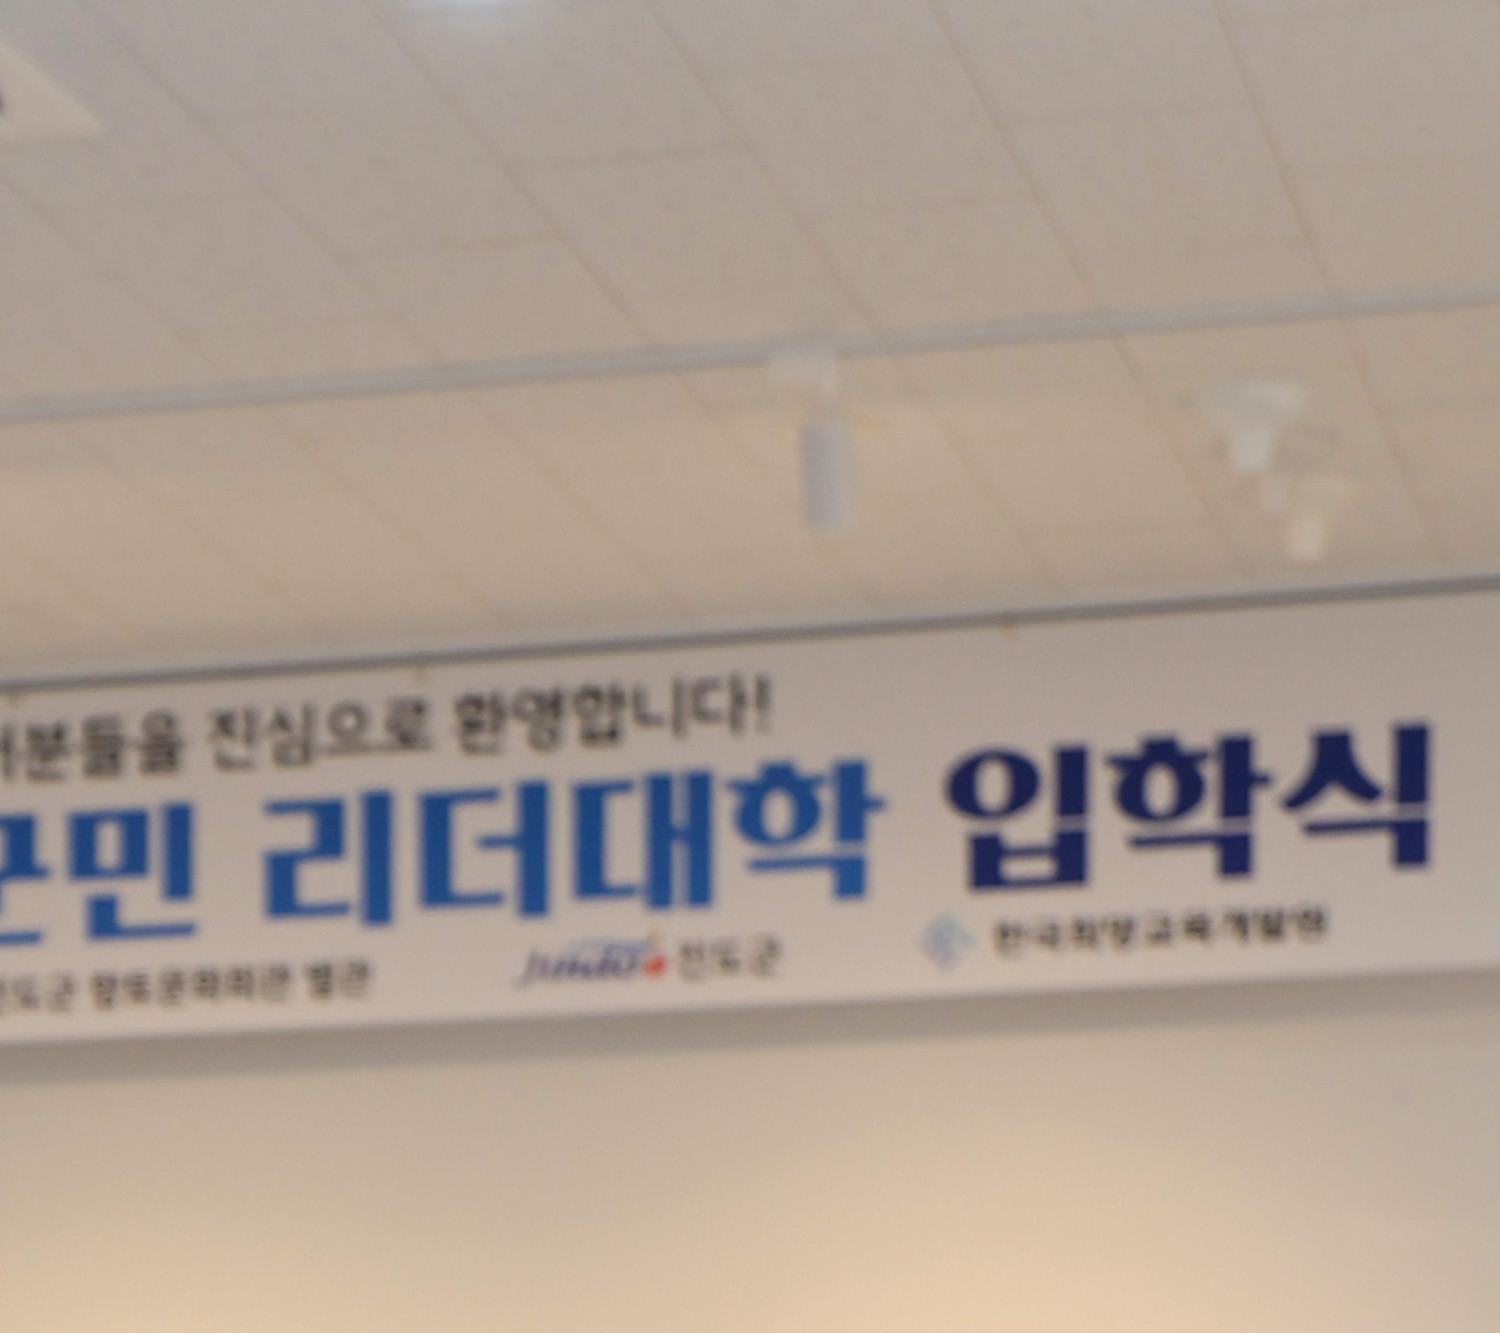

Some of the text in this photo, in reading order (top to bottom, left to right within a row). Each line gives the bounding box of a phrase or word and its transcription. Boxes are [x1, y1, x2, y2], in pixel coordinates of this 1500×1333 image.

[209, 698, 432, 771] 진심으로
[455, 675, 772, 755] 환영합니다!
[262, 757, 884, 927] 리더대학
[945, 722, 1432, 891] 입학식
[678, 936, 781, 979] 진도군
